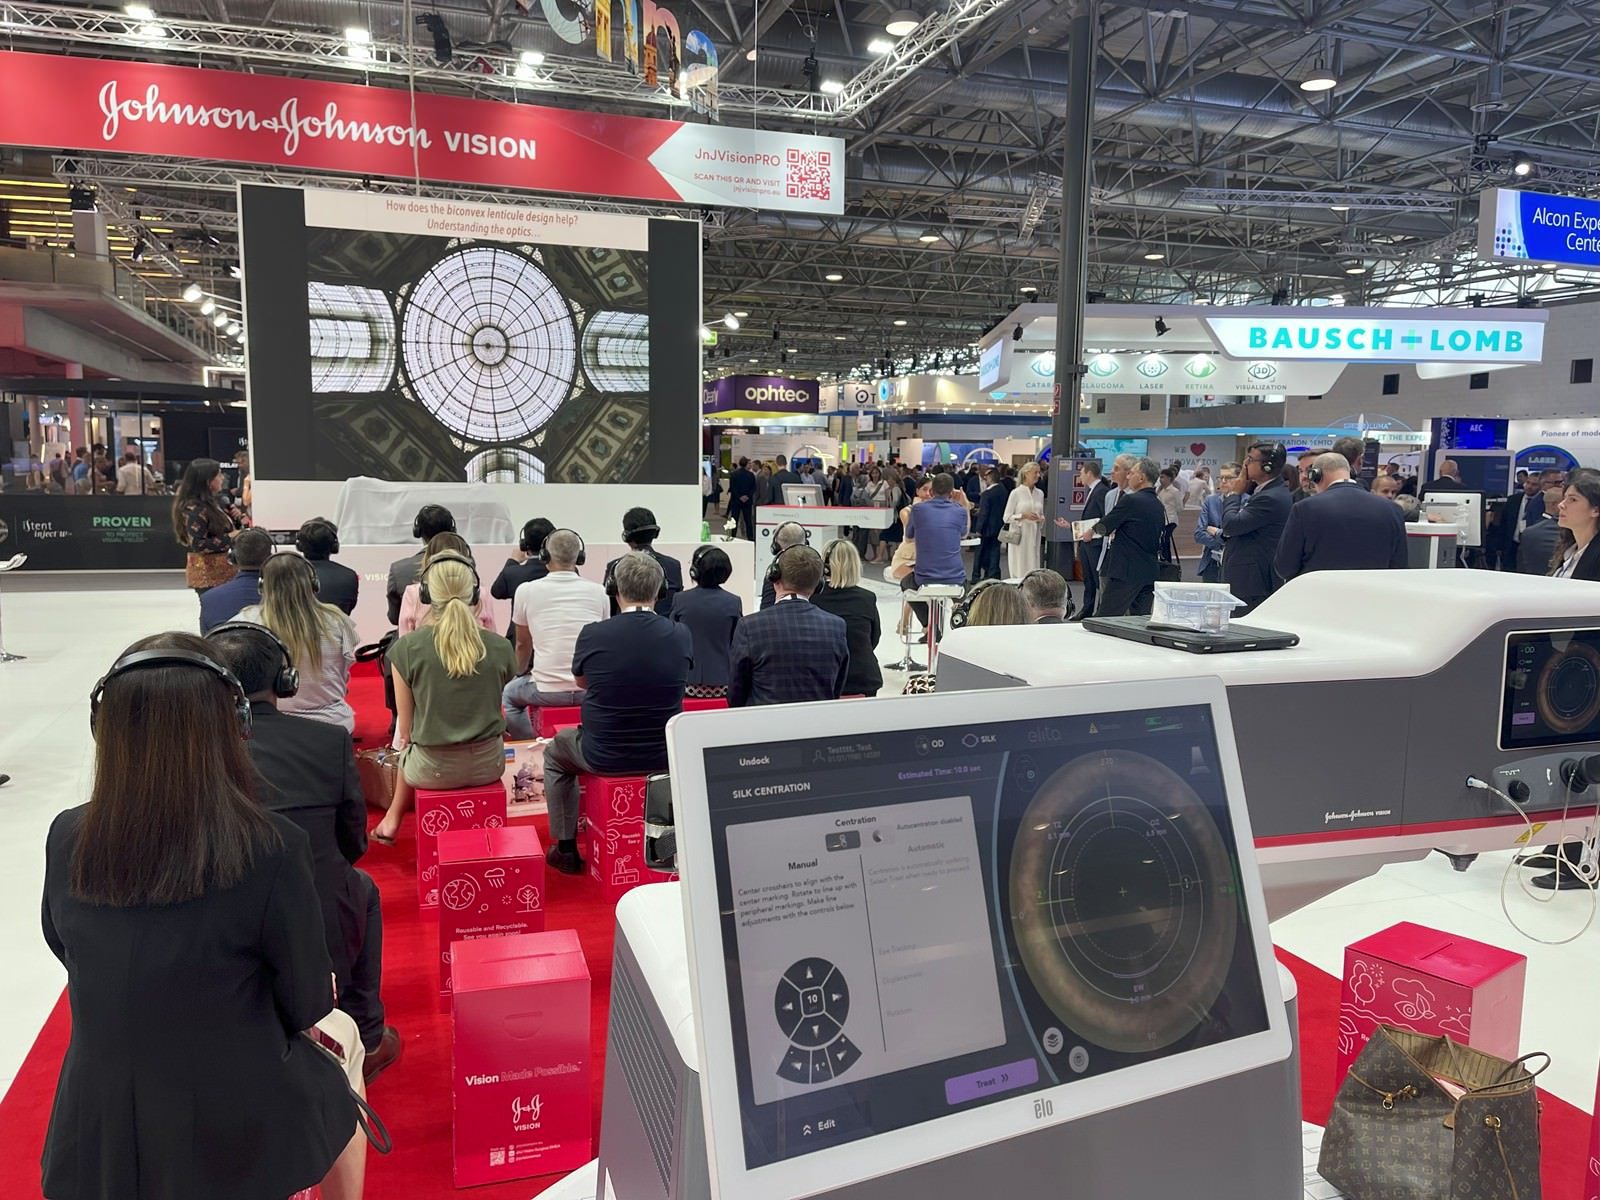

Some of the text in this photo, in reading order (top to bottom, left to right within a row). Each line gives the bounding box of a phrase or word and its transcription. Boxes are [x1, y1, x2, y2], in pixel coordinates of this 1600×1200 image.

[444, 131, 536, 160] VISION
[695, 148, 781, 167] JnJVisionPRO
[694, 173, 781, 187] SCAN THIS QR AND VISIT
[386, 200, 578, 228] How does the biconvex lenticule design help?
[1532, 207, 1570, 227] Alcon
[427, 219, 489, 236] Understanding
[490, 223, 504, 235] the
[745, 385, 809, 404] ophtec
[93, 516, 152, 527] PROVEN
[931, 739, 945, 748] OD
[980, 734, 997, 743] SILK
[739, 755, 771, 767] Undock
[898, 768, 933, 780] Estimated
[732, 782, 811, 799] SILK CENTRATION
[835, 815, 877, 827] Centration
[788, 858, 818, 870] Manual
[738, 886, 761, 896] Center
[795, 879, 802, 887] to
[803, 877, 818, 888] align
[819, 875, 833, 883] with
[833, 873, 845, 882] the
[740, 897, 761, 907] center
[791, 888, 813, 898] Rotate
[814, 887, 821, 895] to
[835, 884, 843, 894] up
[844, 881, 857, 890] with
[740, 906, 774, 918] peripheral
[807, 896, 825, 906] Make
[742, 914, 782, 928] adjustments
[782, 911, 796, 921] with
[797, 909, 808, 918] the
[809, 905, 835, 917] controls
[455, 926, 483, 934] Reusable
[806, 993, 818, 1004] 10
[465, 1073, 499, 1087] Vision
[501, 1068, 533, 1082] Made
[976, 1077, 996, 1089] Treat
[514, 1122, 541, 1132] VISION
[818, 1119, 836, 1131] Edit
